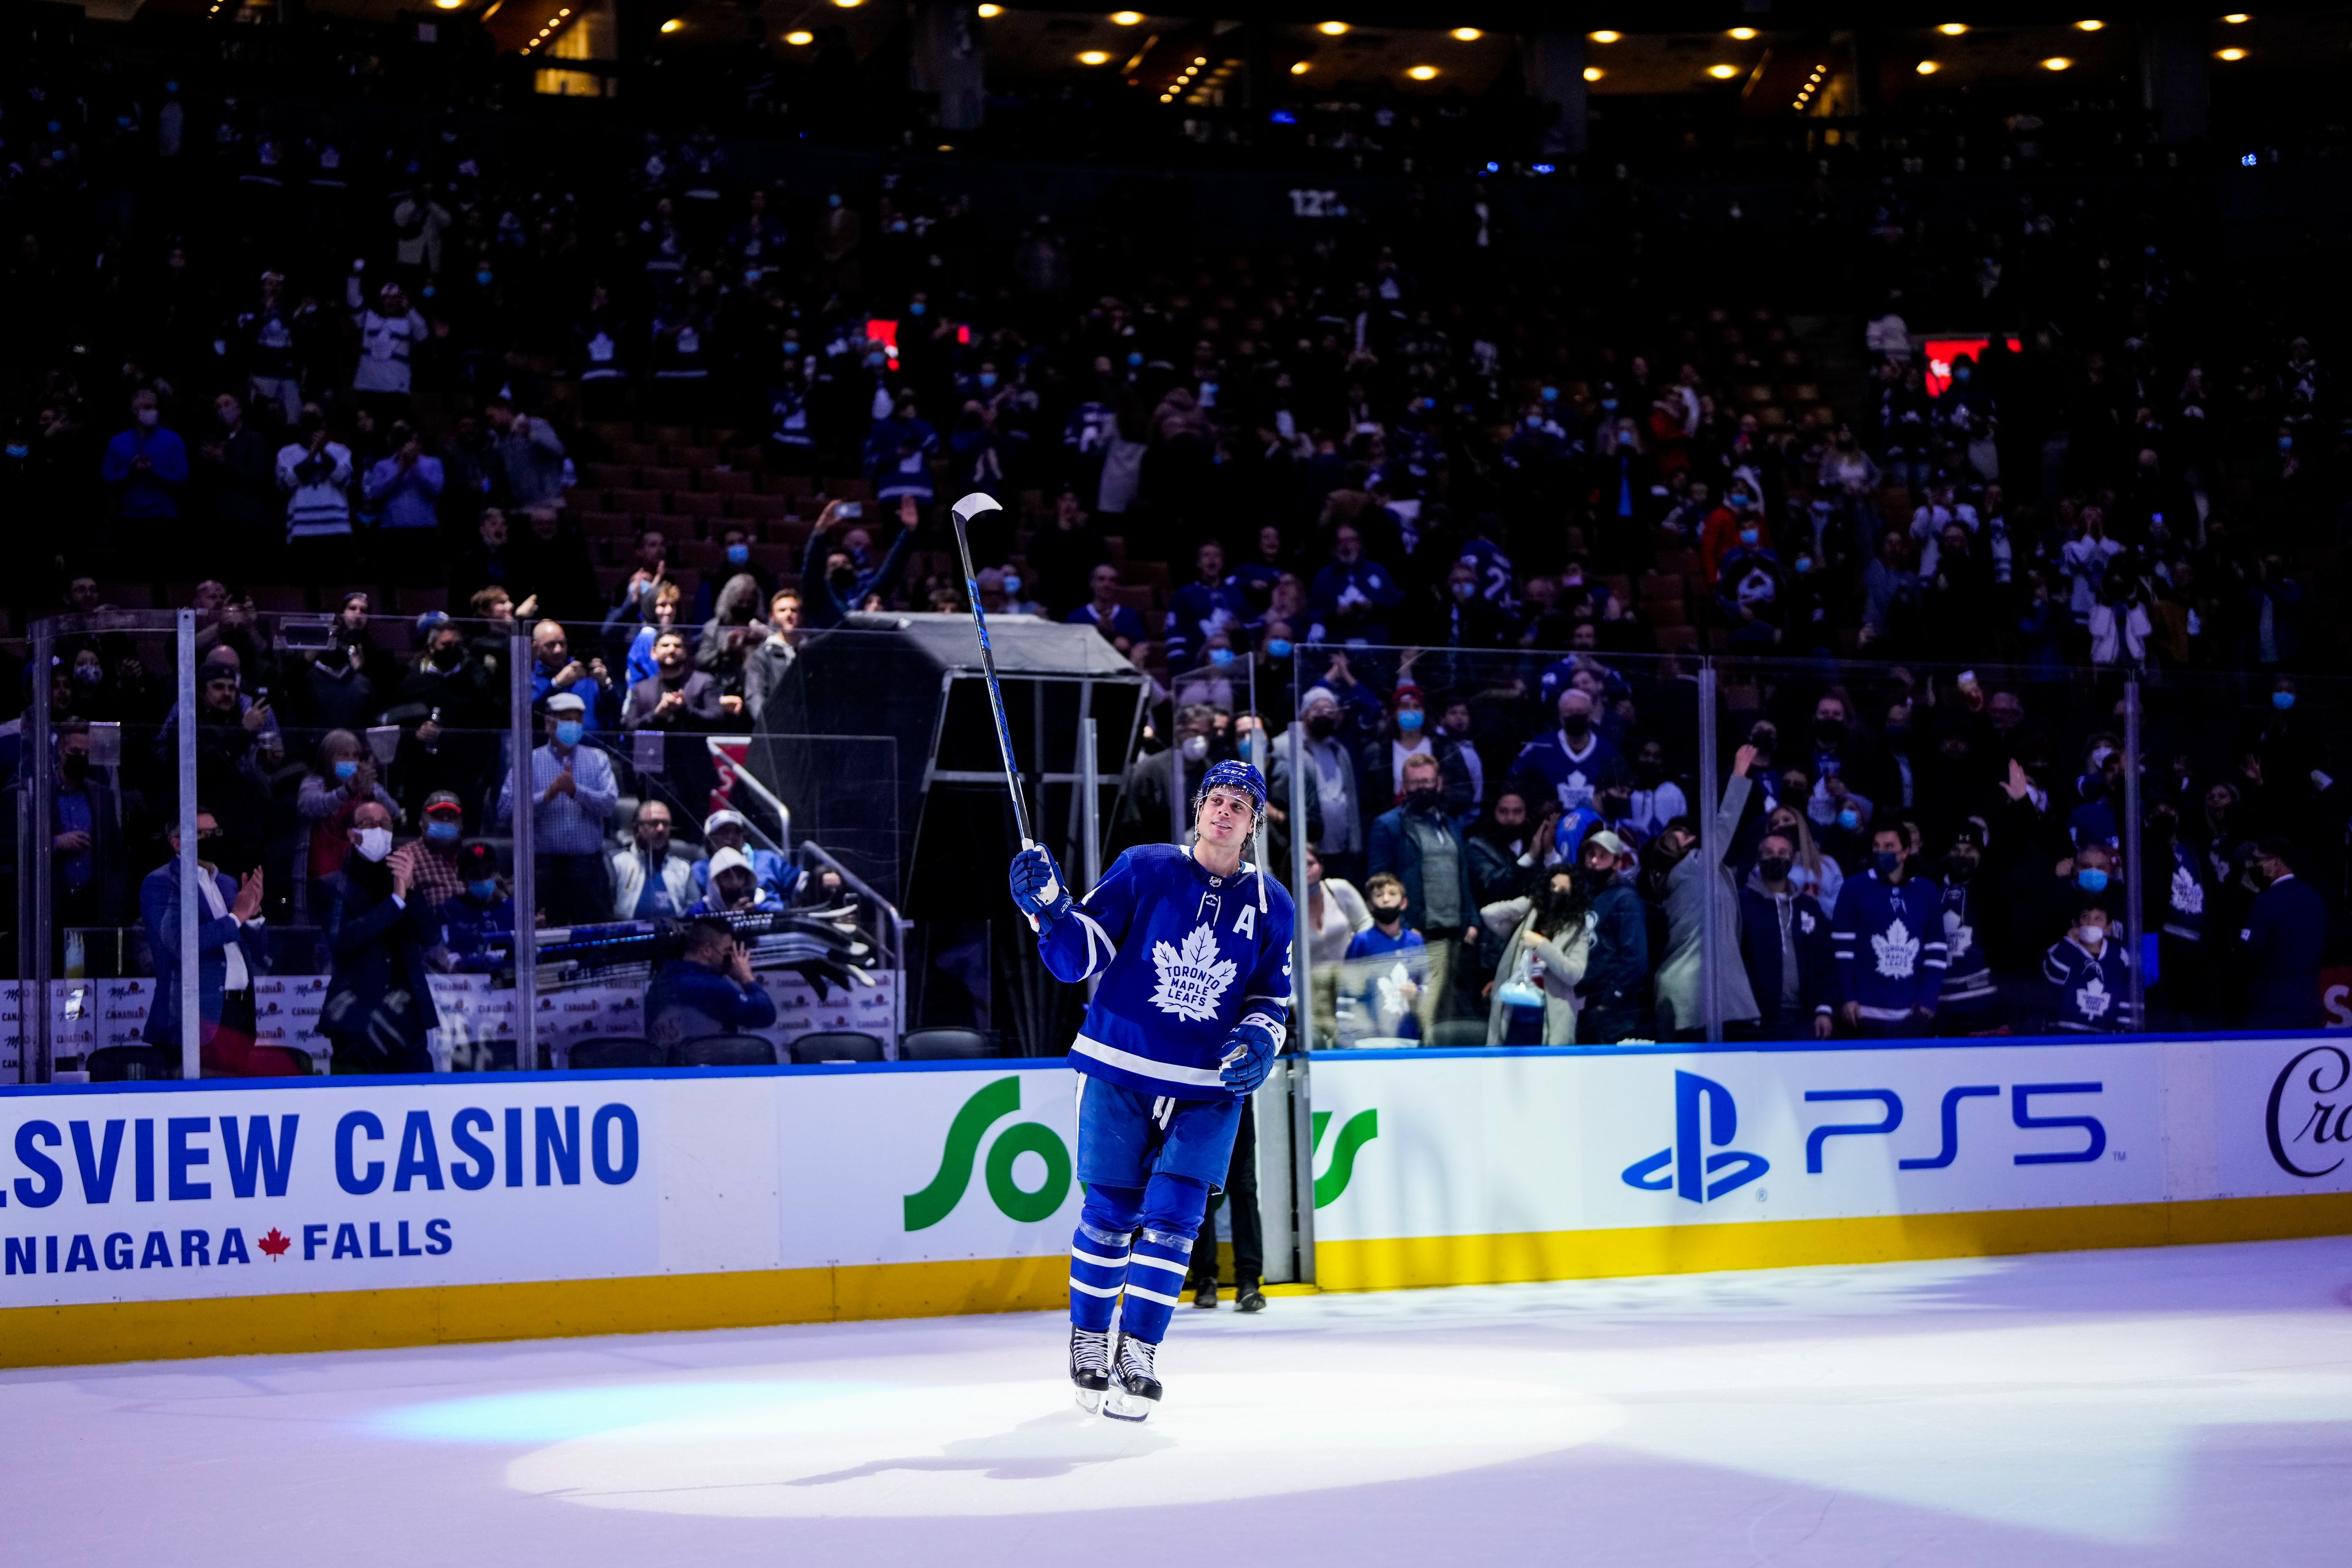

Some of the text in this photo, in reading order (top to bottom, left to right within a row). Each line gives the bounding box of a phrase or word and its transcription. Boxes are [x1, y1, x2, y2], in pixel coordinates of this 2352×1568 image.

[1232, 904, 1256, 940] A
[1165, 966, 1220, 990] TORONTO
[1171, 977, 1209, 996] MAPLE
[1167, 988, 1206, 1006] LEAFS
[1804, 1081, 2107, 1174] PS5
[0, 1103, 639, 1209] SVIEW CASINO
[5, 1219, 452, 1275] NIAGARA FALLS
[1116, 1362, 1125, 1379] CCM
